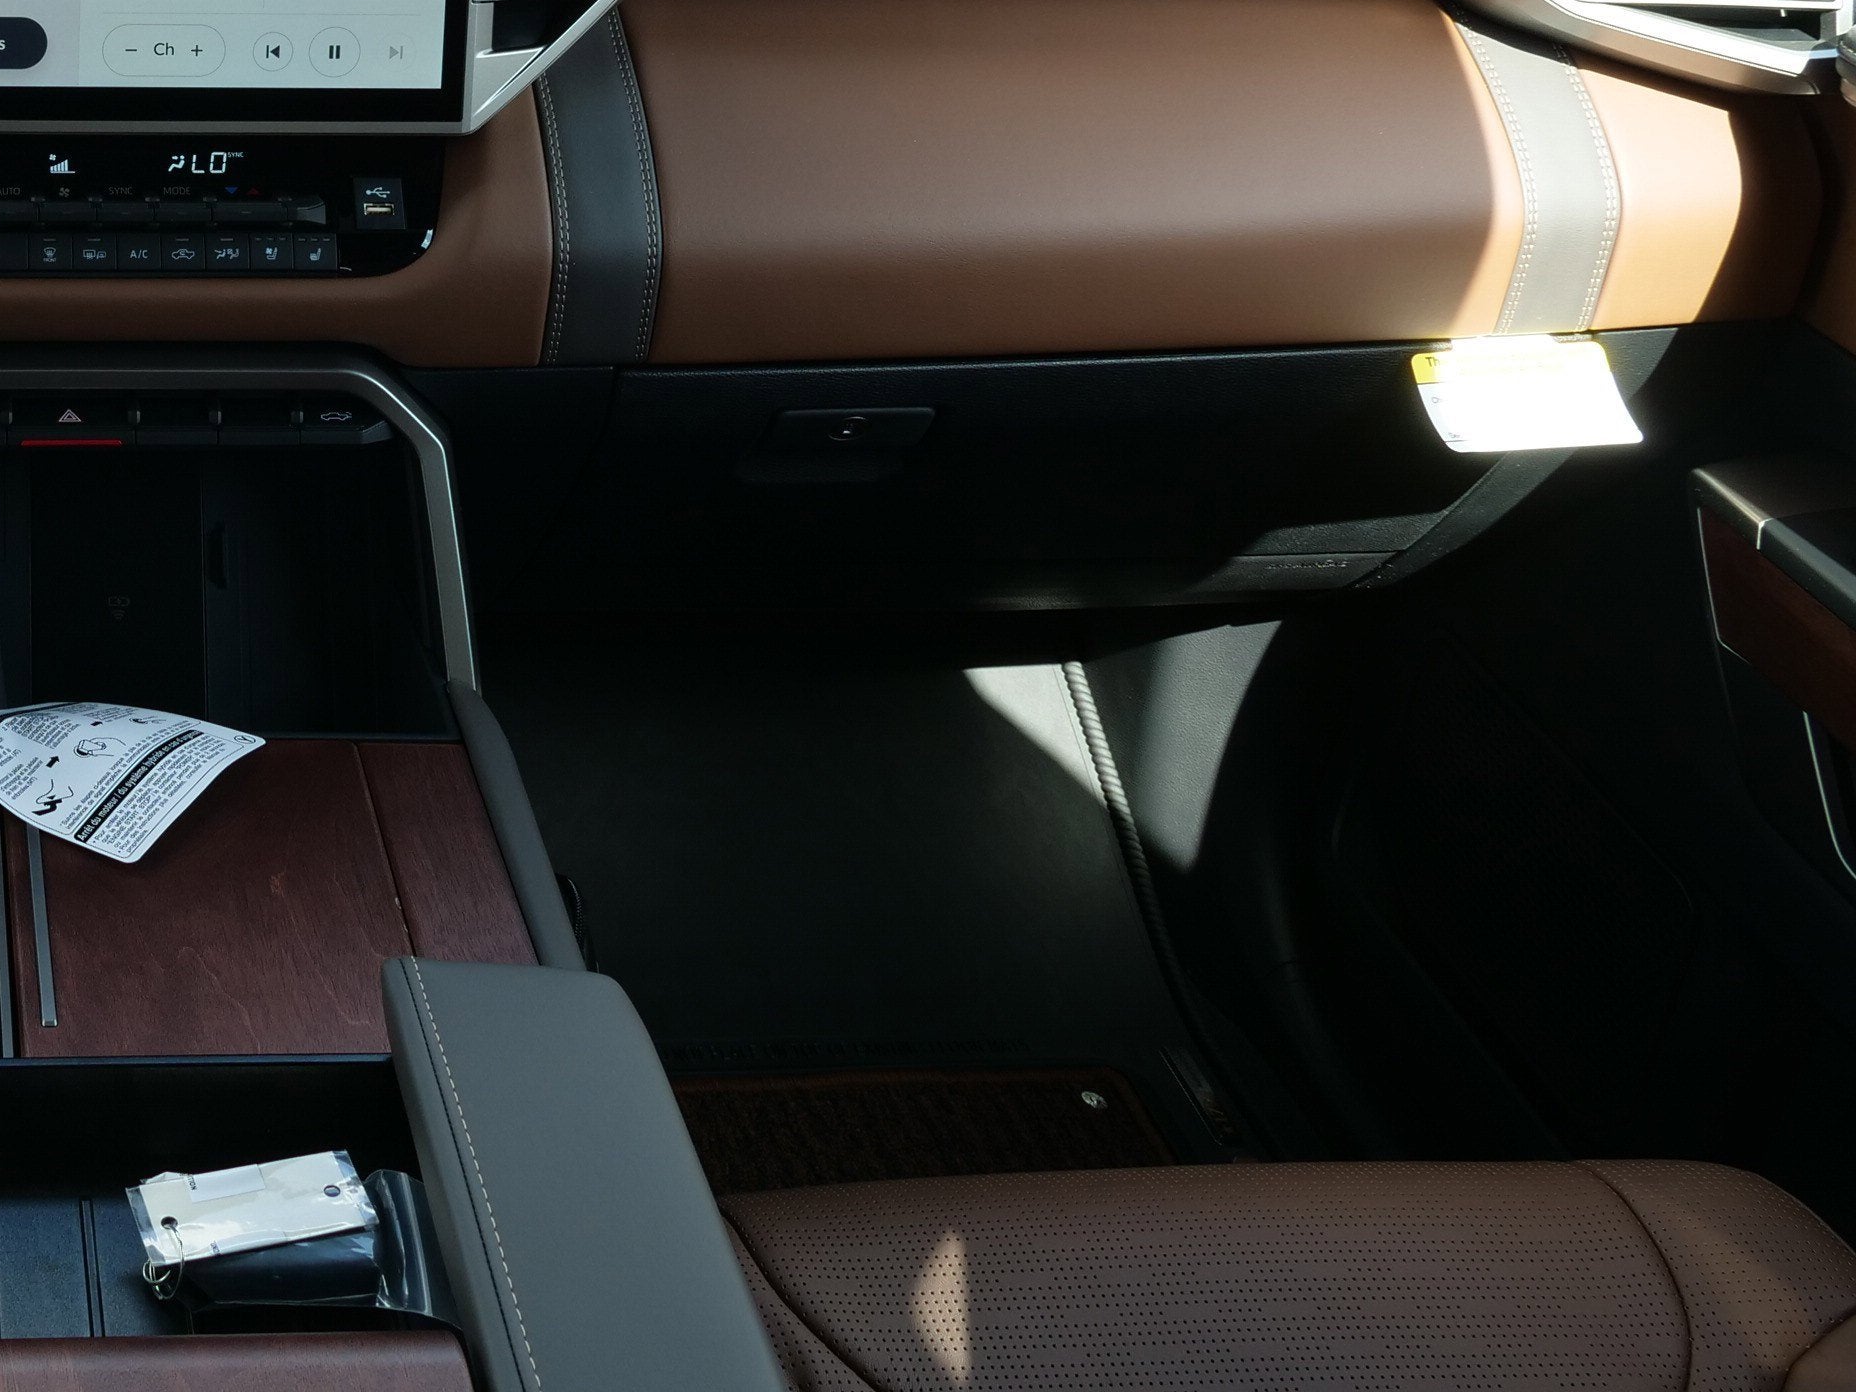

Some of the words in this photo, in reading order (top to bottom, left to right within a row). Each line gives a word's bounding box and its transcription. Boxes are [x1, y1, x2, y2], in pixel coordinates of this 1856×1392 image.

[154, 42, 174, 56] Ch
[108, 186, 133, 196] SYNC
[163, 186, 191, 196] MODE
[130, 248, 148, 259] A/C
[75, 820, 95, 841] Arrêt
[89, 814, 102, 826] du
[97, 795, 119, 818] moteur
[116, 783, 128, 795] du
